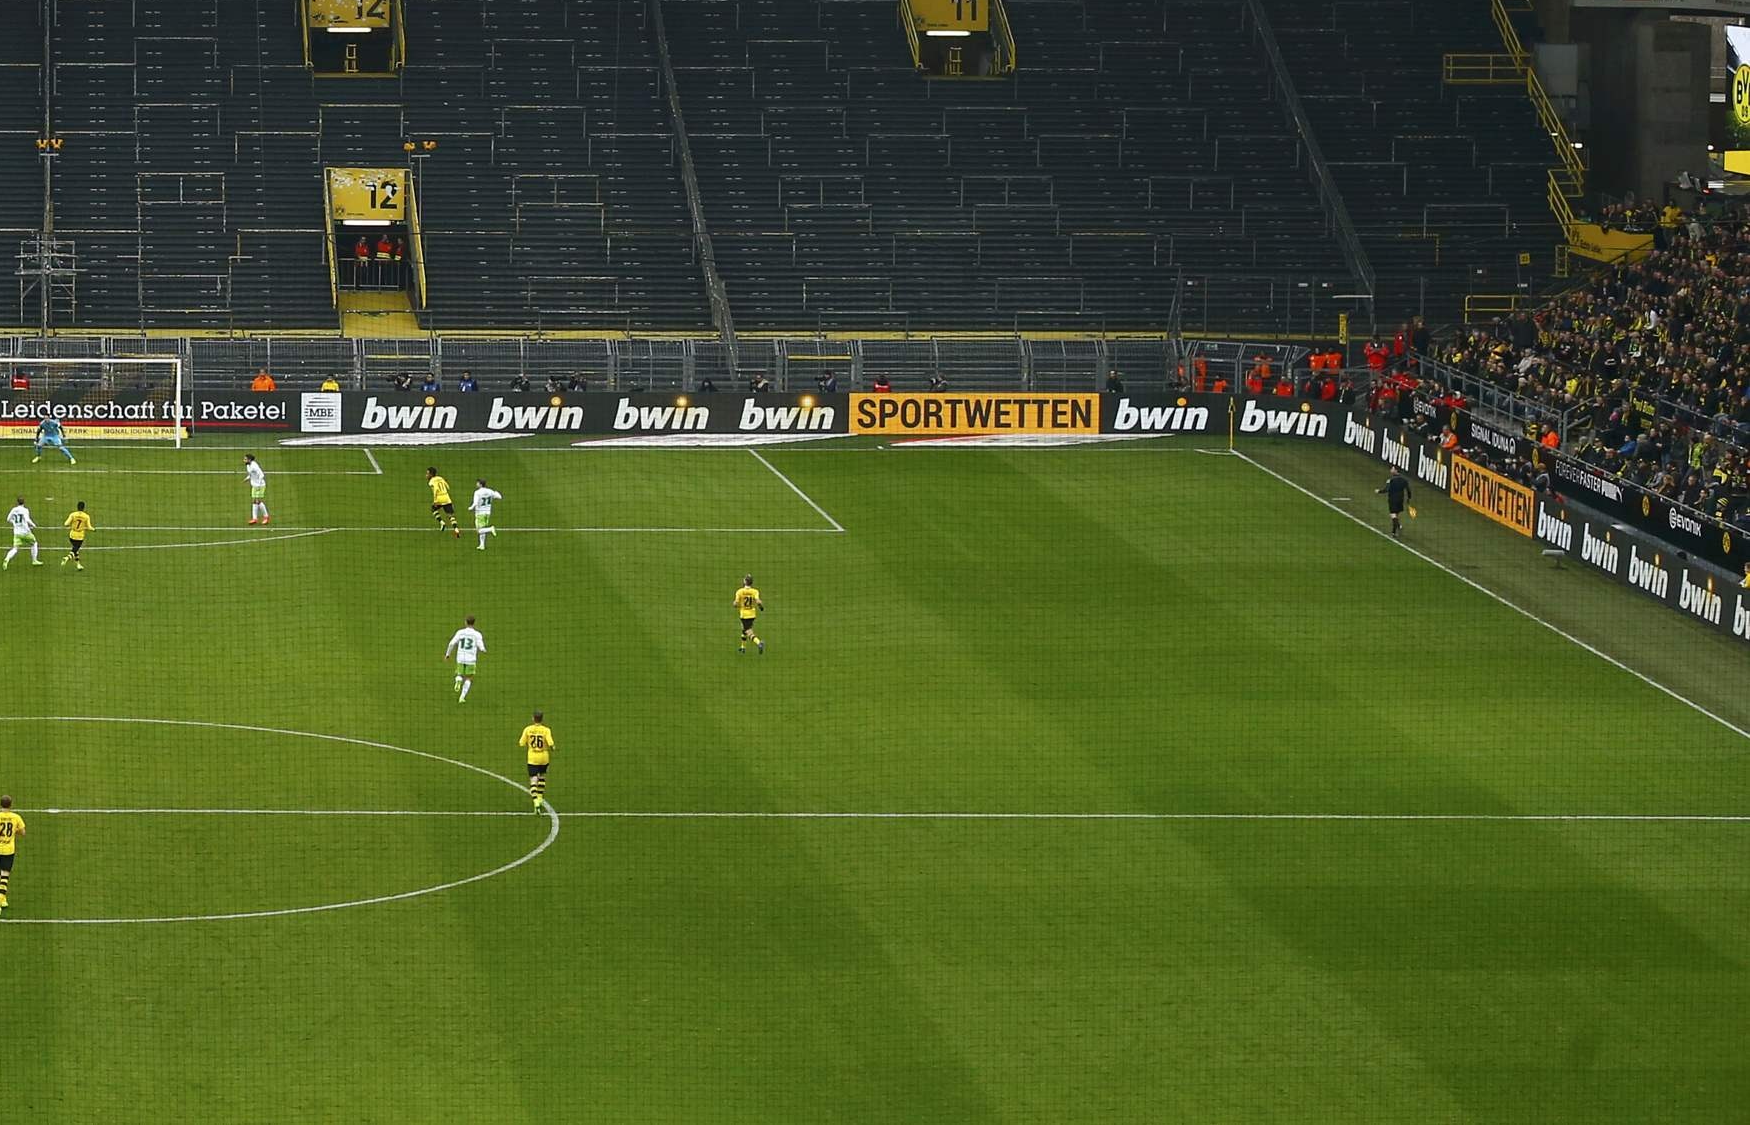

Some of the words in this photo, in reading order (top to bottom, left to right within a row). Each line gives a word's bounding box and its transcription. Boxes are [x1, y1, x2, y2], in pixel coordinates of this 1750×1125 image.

[365, 181, 398, 210] 12
[1, 399, 155, 421] Leidenschaft
[201, 400, 286, 421] Pakete!
[309, 407, 334, 417] MBE
[361, 396, 458, 430] bwin
[487, 396, 584, 430] bwin
[613, 396, 709, 430] bwin
[739, 396, 835, 431] bwin
[857, 398, 1092, 429] SPORTWETTEN
[1113, 397, 1209, 431] bwin
[1239, 400, 1328, 438] bwin
[1344, 412, 1375, 455] bwin
[1381, 427, 1410, 472] bwin
[1417, 444, 1447, 490] bwin
[1453, 461, 1531, 530] SPORTWETTEN
[1537, 501, 1572, 551] bwin
[1677, 515, 1702, 538] EVONIK
[1581, 522, 1619, 575] bwin
[1628, 545, 1668, 599] bwin
[1679, 569, 1721, 625] bwin
[459, 638, 473, 650] 13
[0, 822, 13, 838] 28
